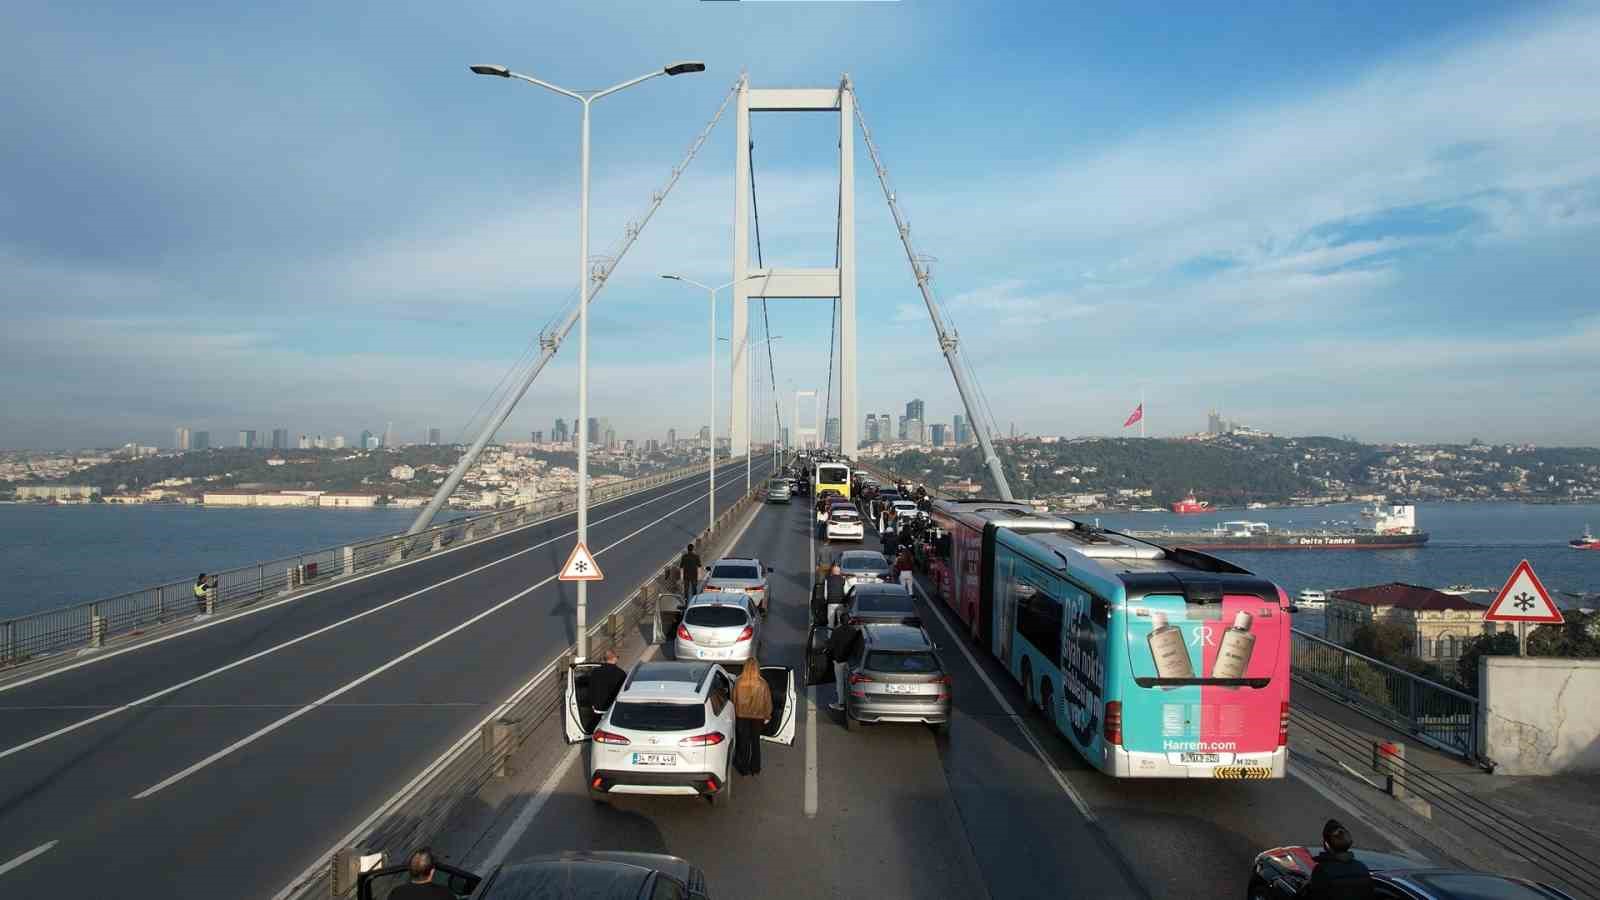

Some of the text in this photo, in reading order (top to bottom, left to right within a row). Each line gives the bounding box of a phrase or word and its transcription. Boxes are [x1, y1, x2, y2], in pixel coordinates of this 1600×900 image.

[1300, 537, 1356, 545] Delta Tankers
[1163, 740, 1237, 751] Harrem.com
